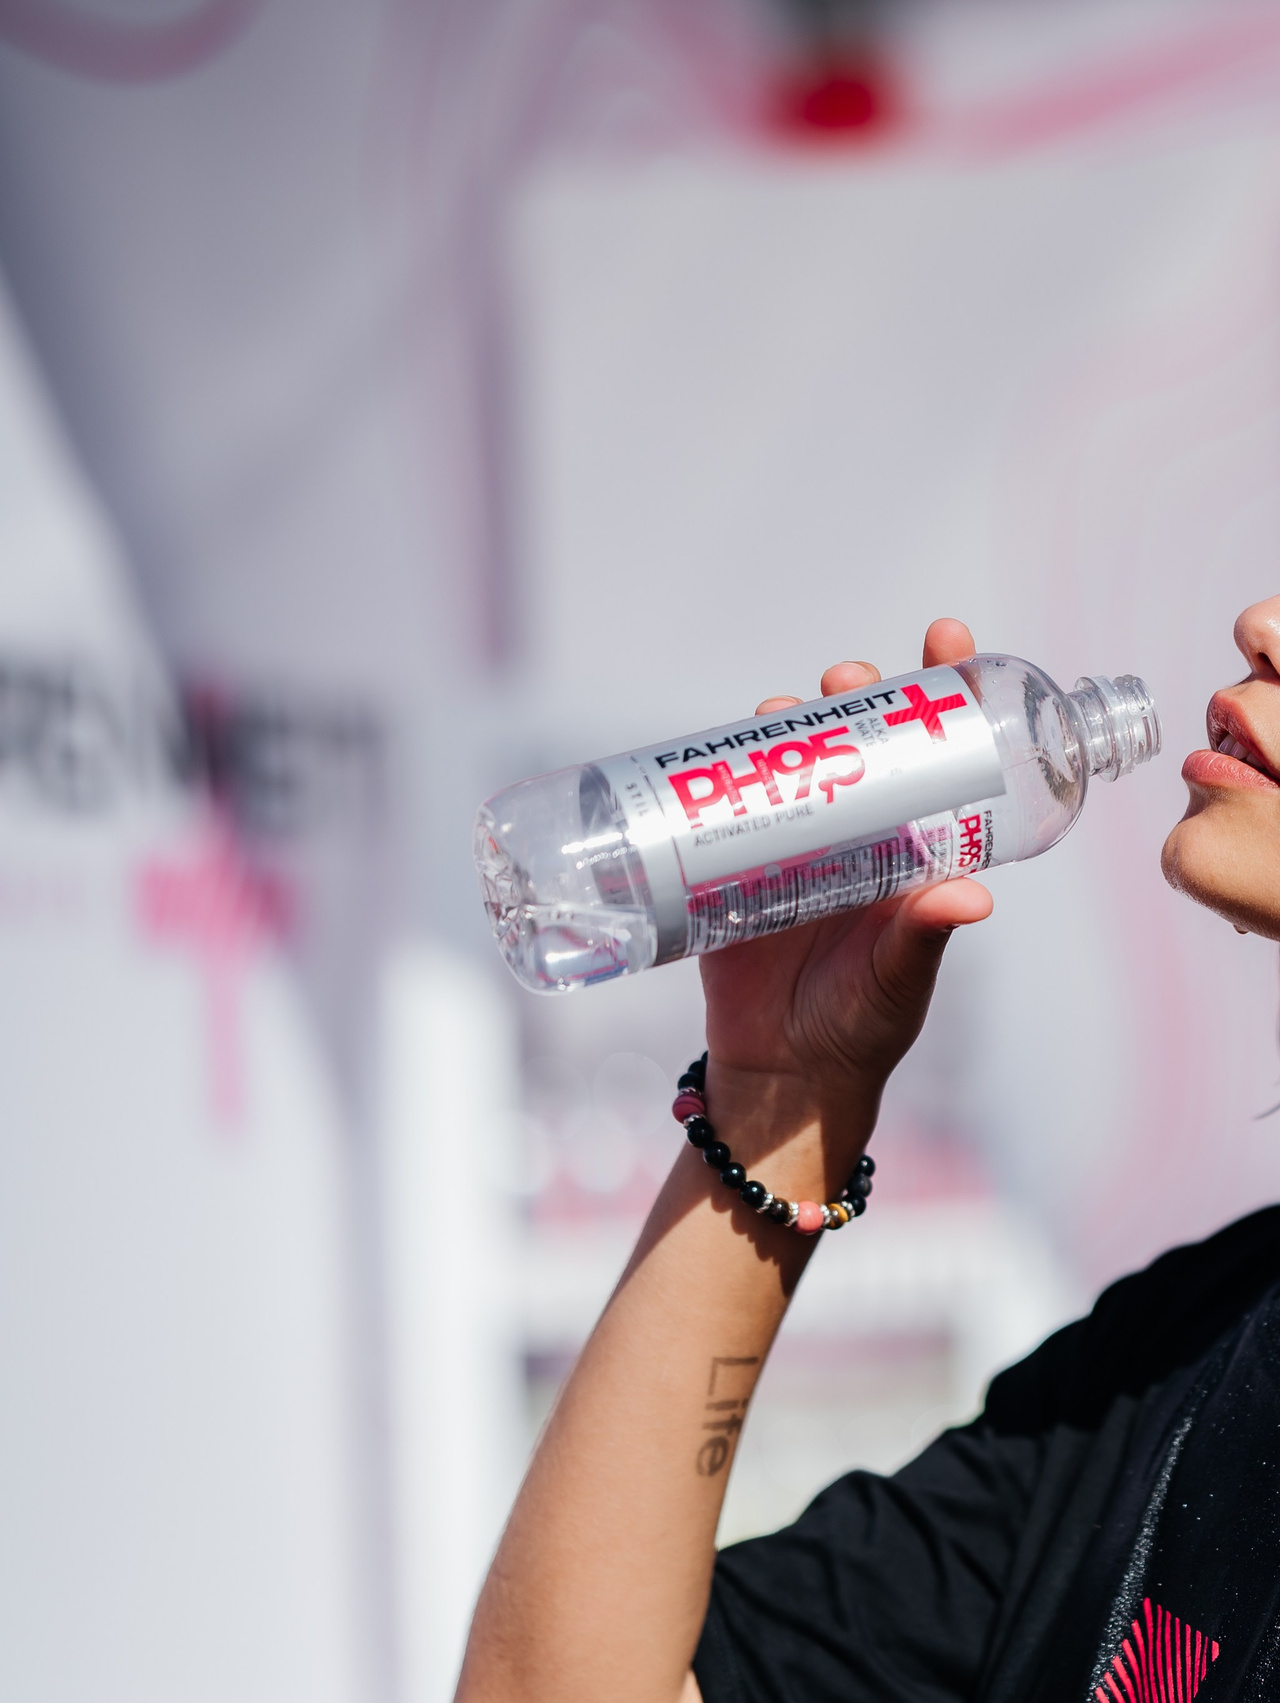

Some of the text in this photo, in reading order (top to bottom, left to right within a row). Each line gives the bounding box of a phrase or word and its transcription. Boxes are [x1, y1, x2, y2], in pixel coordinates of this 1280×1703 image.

[655, 690, 897, 769] FAHRENHEIT
[855, 719, 877, 748] WATE
[625, 782, 650, 817] STIL
[694, 803, 815, 849] ACTIVATED PURE
[696, 1356, 760, 1477] Life
